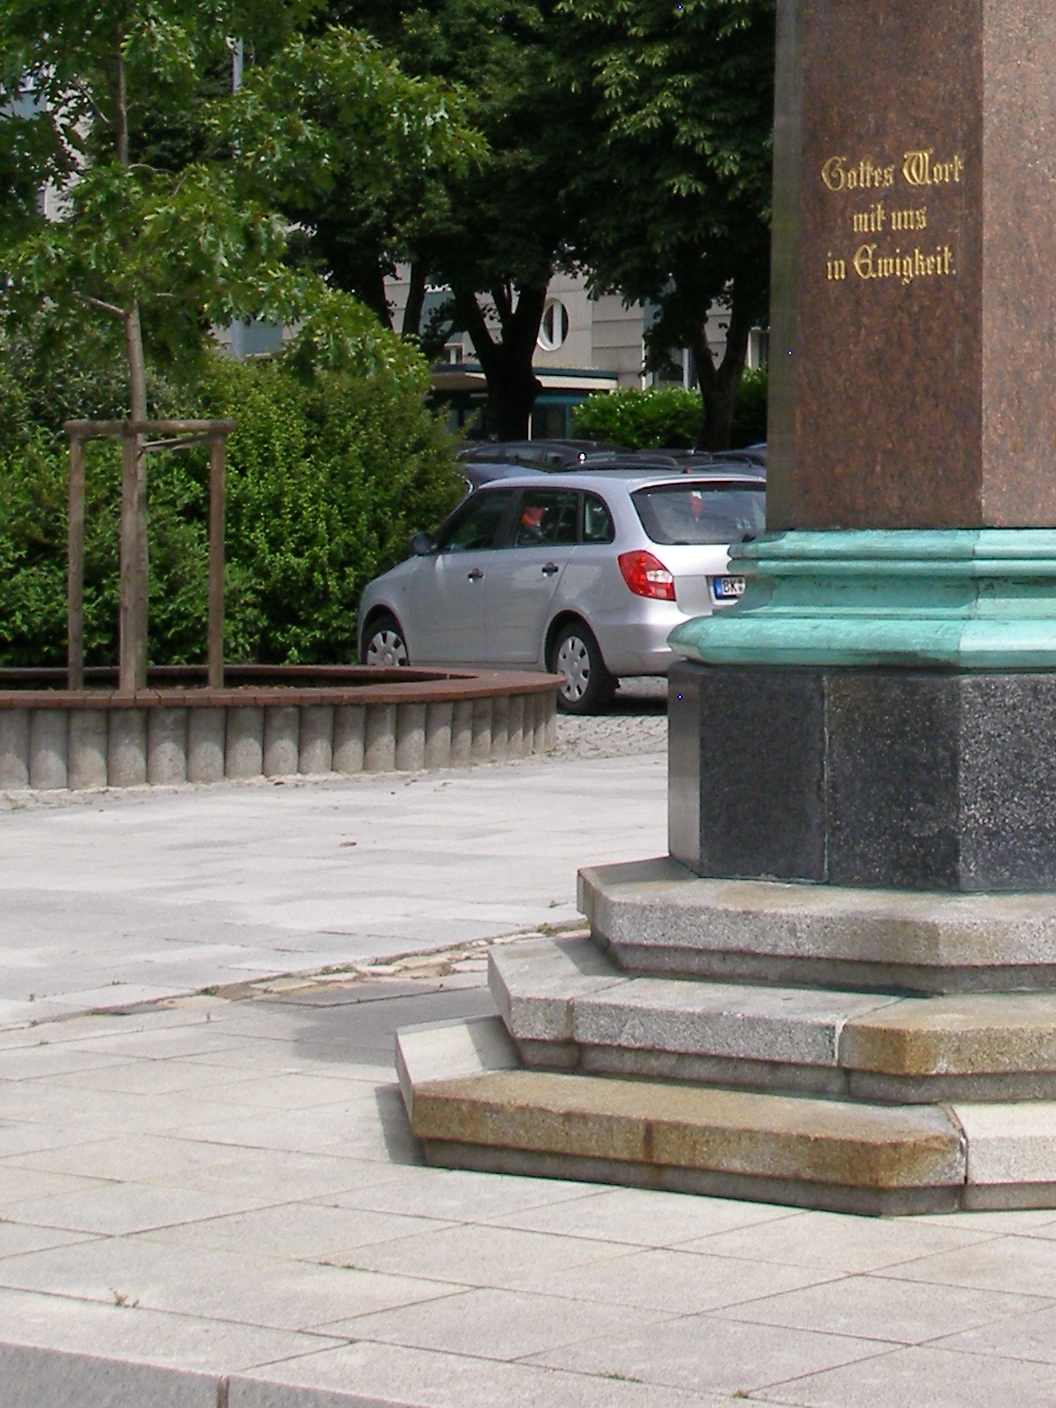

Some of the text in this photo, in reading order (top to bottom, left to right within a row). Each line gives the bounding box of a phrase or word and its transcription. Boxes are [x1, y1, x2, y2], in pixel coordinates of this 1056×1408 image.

[821, 148, 964, 191] Gottes Wort
[853, 201, 927, 232] mit uns
[826, 250, 847, 280] in
